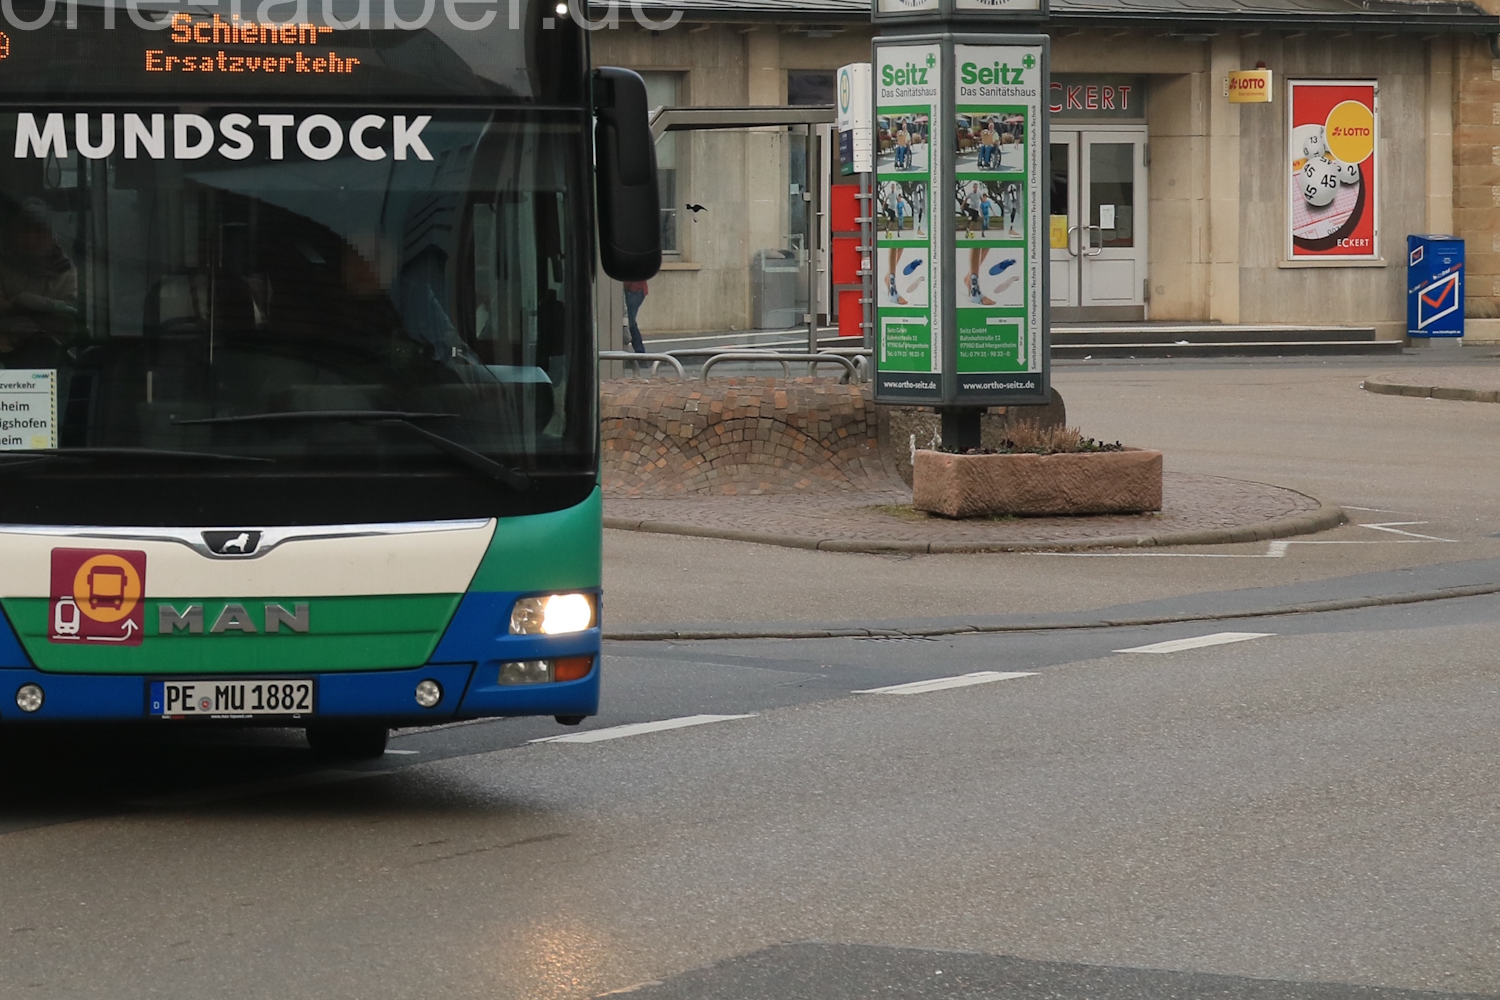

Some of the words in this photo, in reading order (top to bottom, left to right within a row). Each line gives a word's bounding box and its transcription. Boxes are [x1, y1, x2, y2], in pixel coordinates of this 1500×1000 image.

[171, 13, 333, 44] Schienen-
[145, 49, 360, 74] Ersatzverkehr
[882, 62, 928, 86] Seitz
[960, 61, 1024, 85] Seitz
[1238, 78, 1265, 89] LOTTO
[882, 88, 894, 98] Das
[896, 87, 936, 98] Sanitätshaus
[960, 87, 977, 96] Das
[980, 86, 1036, 97] Sanitätshaus
[14, 113, 434, 161] MUNDSTOCK
[1344, 128, 1370, 136] LOTTO
[1304, 164, 1316, 178] 45
[1347, 165, 1357, 176] 2
[1321, 174, 1337, 188] 45
[1304, 184, 1317, 200] 45
[1337, 238, 1369, 248] ECKERT
[884, 380, 936, 389] www.ortho-seitz.de
[963, 381, 1035, 389] www.ortho-seitz.de
[158, 602, 310, 634] MAN
[167, 685, 195, 711] PE
[215, 685, 245, 710] MU
[252, 684, 309, 710] 1882
